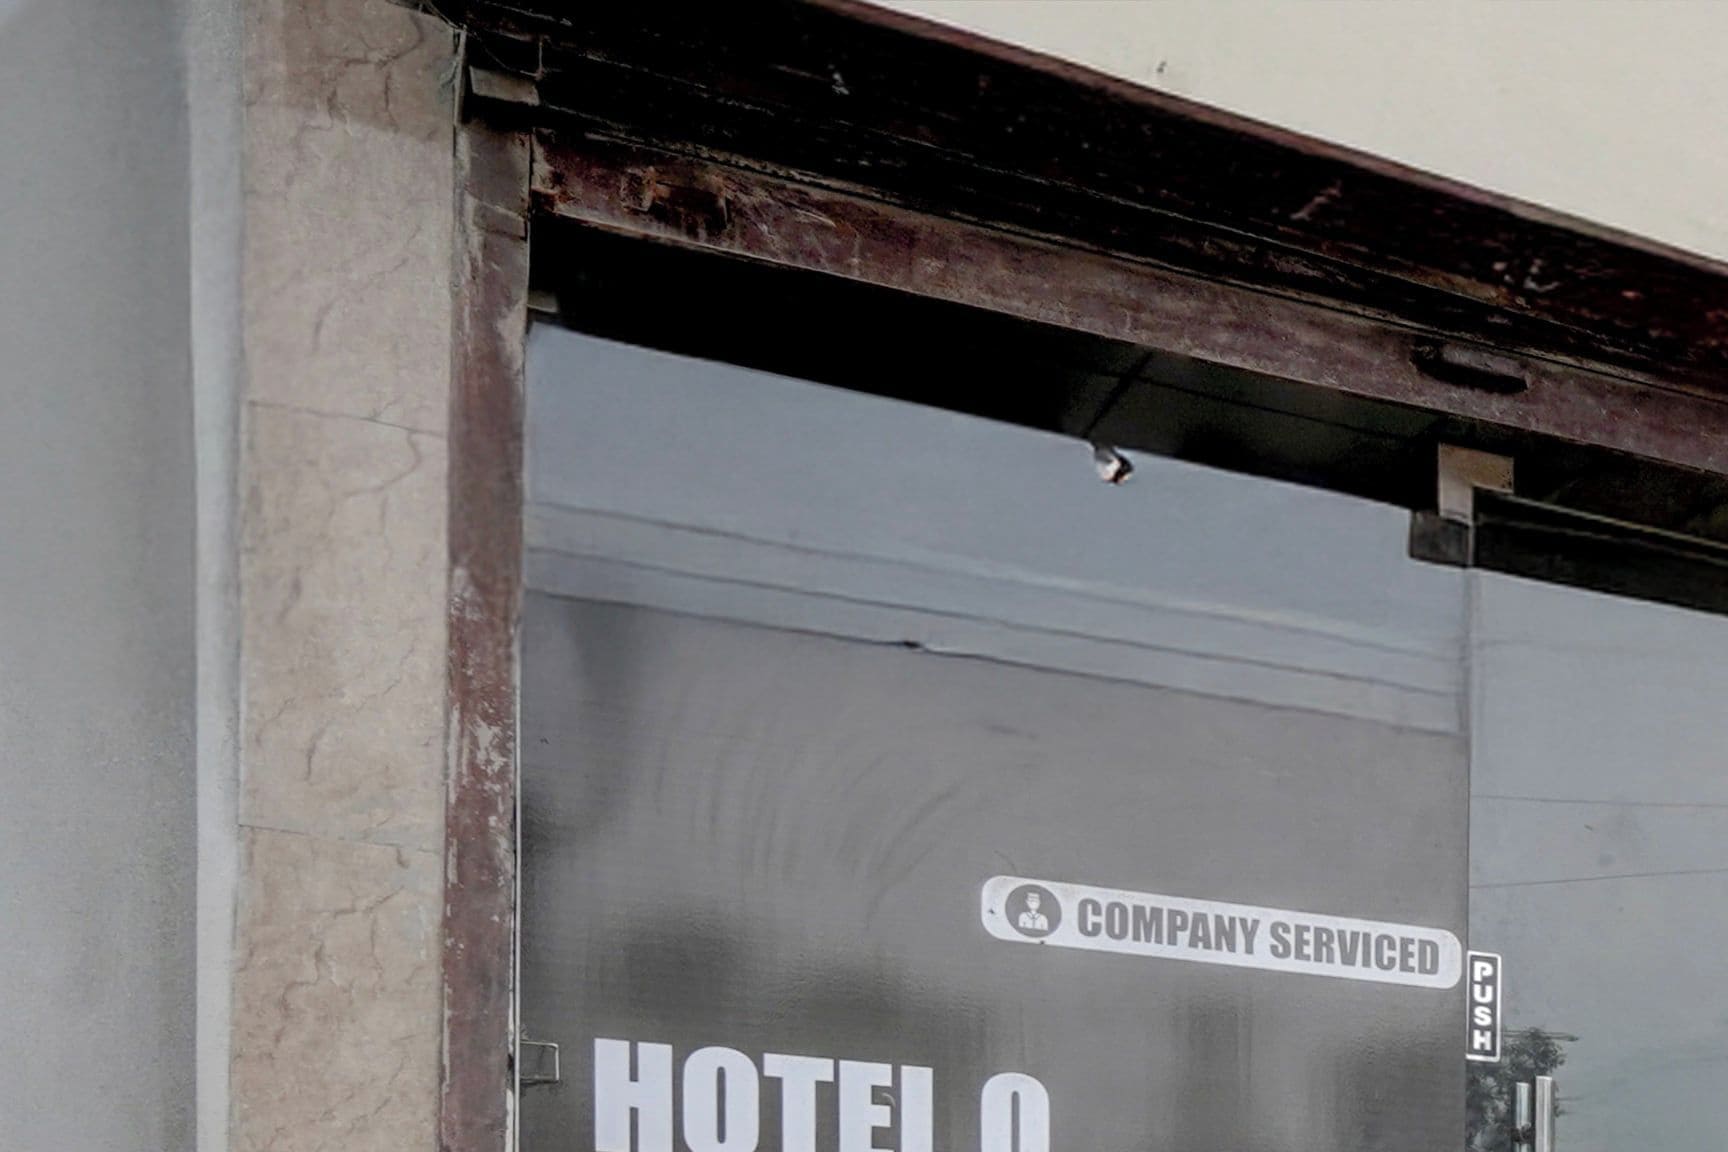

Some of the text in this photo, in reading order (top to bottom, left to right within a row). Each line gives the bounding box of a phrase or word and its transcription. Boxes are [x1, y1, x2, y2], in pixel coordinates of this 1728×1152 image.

[1077, 898, 1439, 976] COMPANY SERVICED
[1473, 960, 1494, 1051] PUSH
